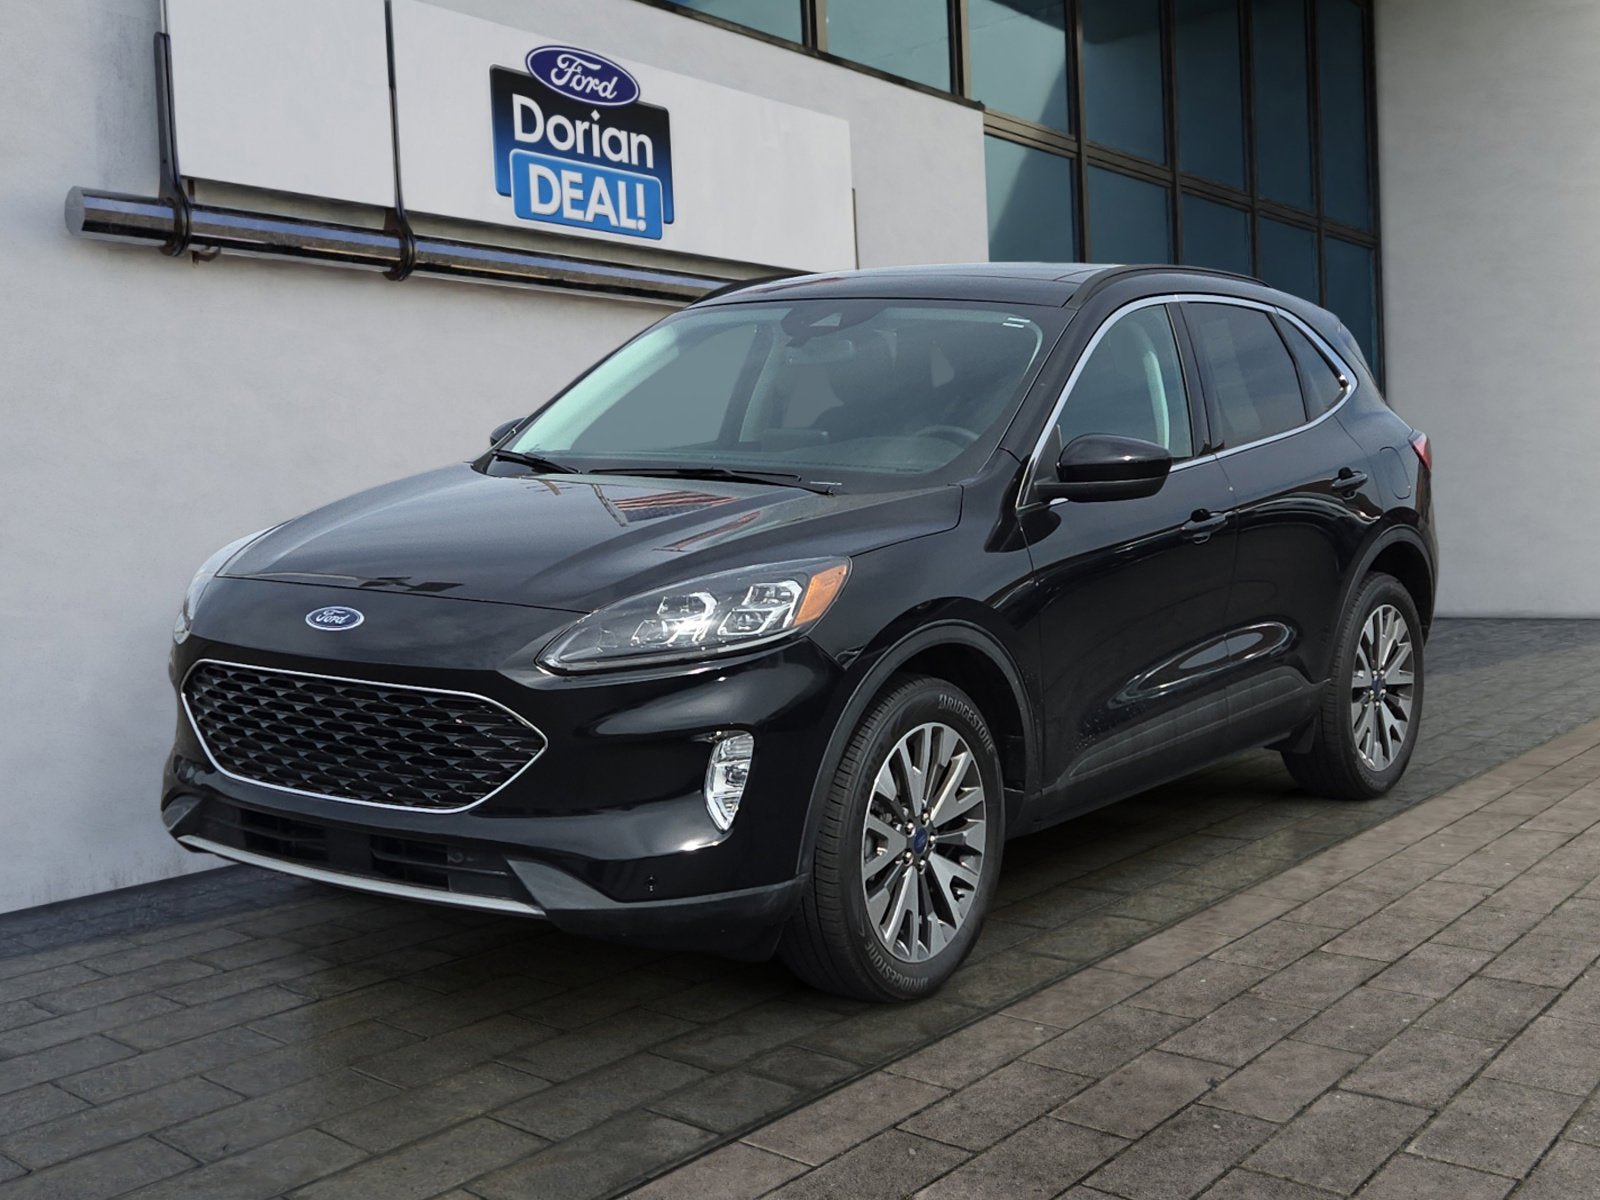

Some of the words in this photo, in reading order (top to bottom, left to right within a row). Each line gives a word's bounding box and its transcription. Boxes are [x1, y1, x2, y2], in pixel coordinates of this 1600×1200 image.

[550, 54, 618, 99] Ford
[512, 93, 654, 169] Dorian
[528, 163, 647, 232] DEAL!
[315, 609, 351, 624] Ford
[938, 694, 994, 755] BRIDGESTONE
